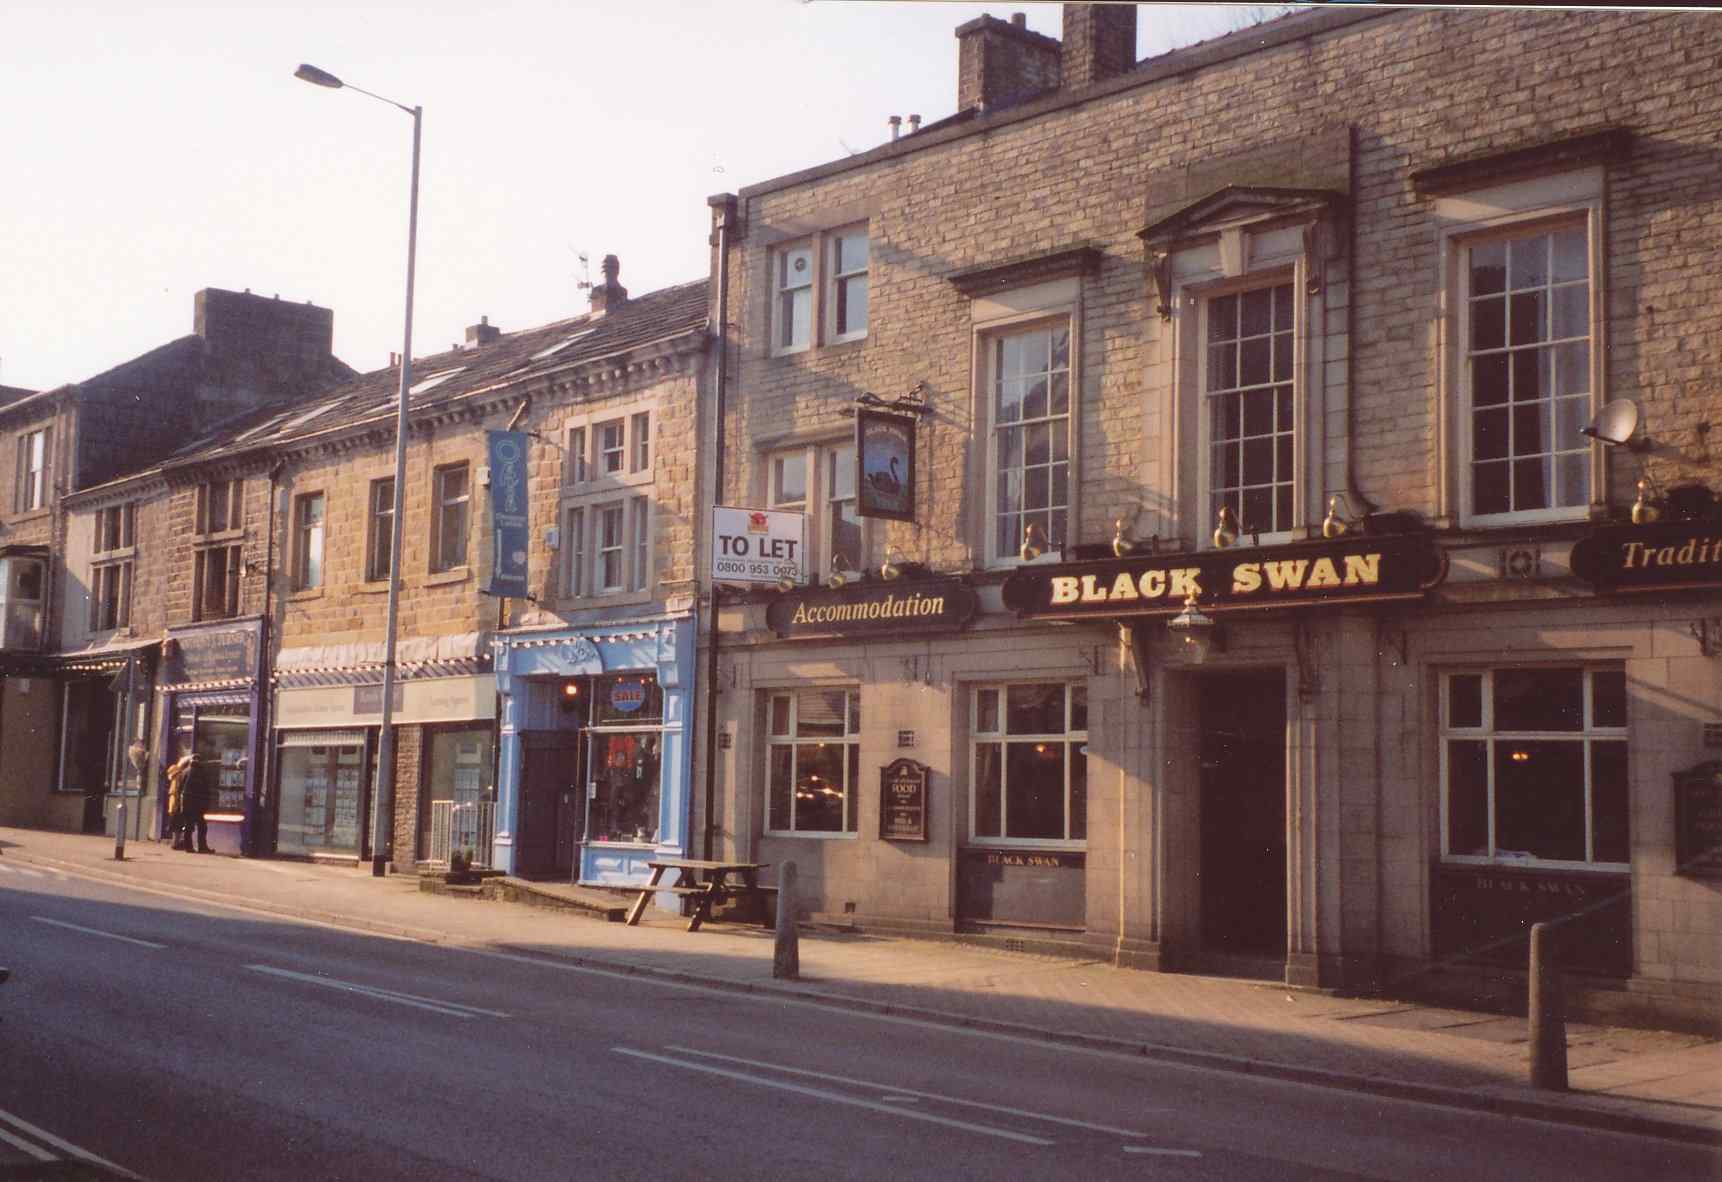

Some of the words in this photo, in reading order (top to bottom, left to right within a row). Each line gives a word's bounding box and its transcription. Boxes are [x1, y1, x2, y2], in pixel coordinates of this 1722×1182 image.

[719, 535, 749, 556] TO
[760, 538, 798, 559] LET
[717, 562, 746, 574] 0800
[749, 564, 769, 575] 953
[1050, 567, 1203, 605] BLACK
[1232, 553, 1382, 593] SWAN
[792, 592, 945, 624] Accommodation
[987, 854, 1025, 865] BLACK
[1027, 855, 1059, 866] SWAN
